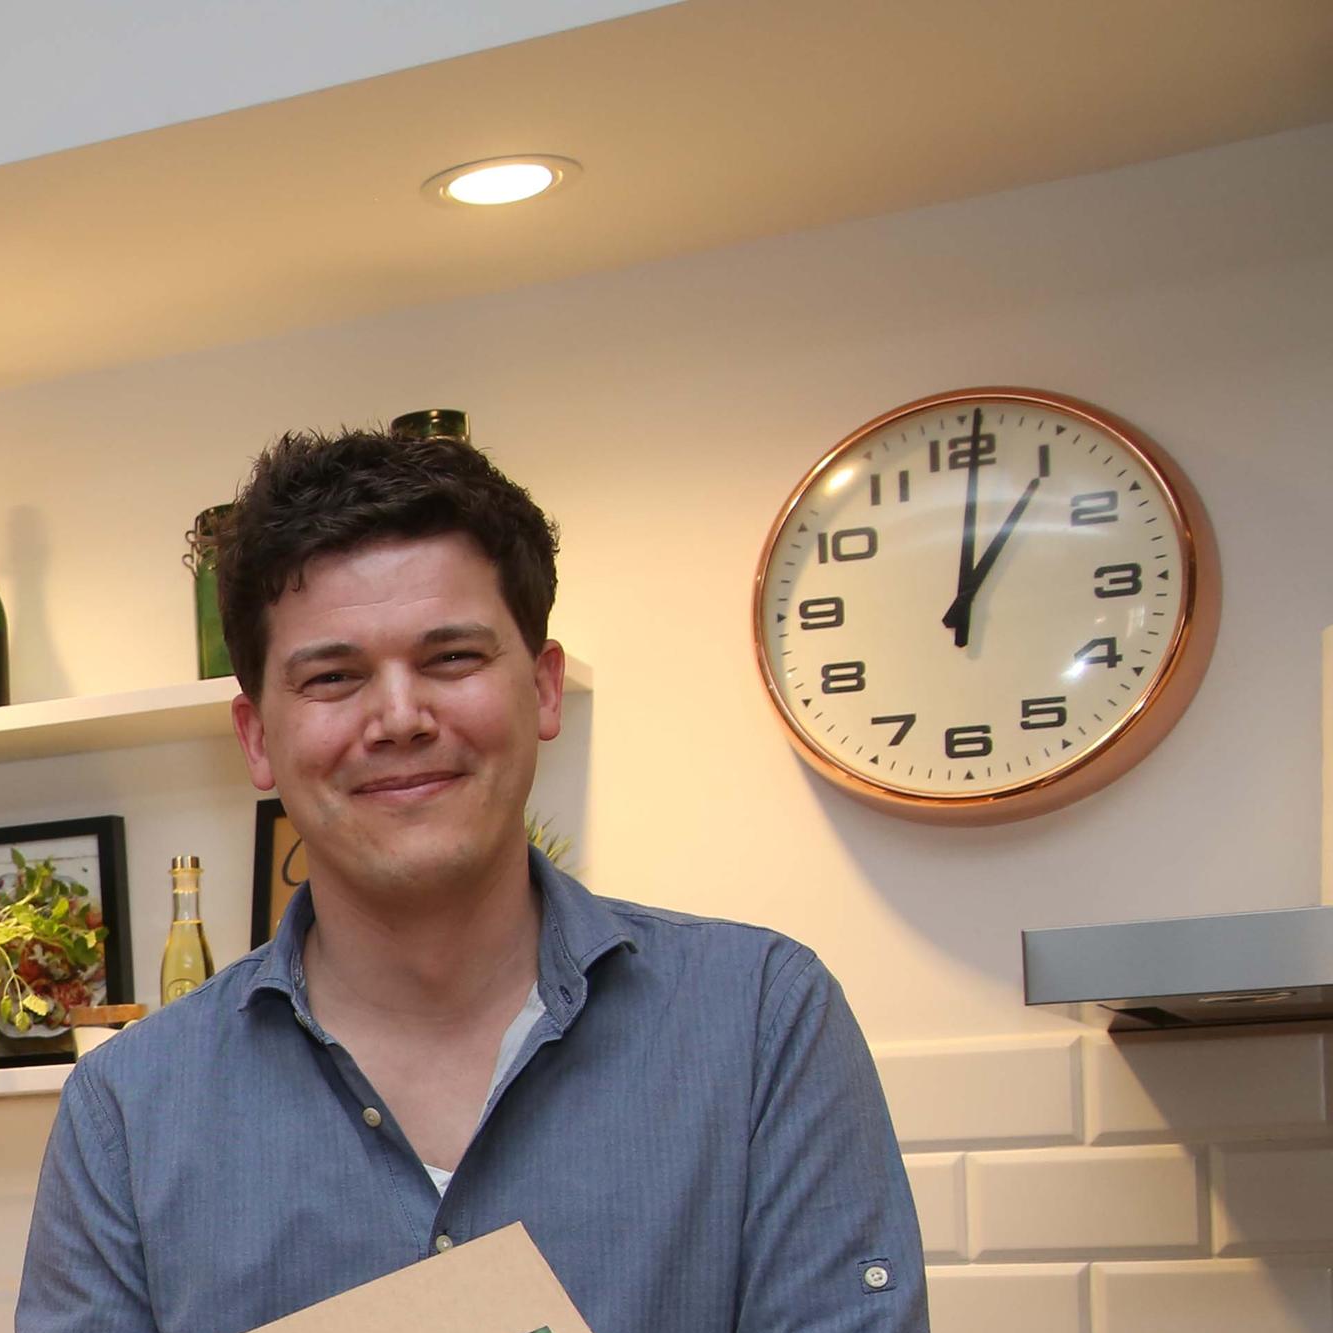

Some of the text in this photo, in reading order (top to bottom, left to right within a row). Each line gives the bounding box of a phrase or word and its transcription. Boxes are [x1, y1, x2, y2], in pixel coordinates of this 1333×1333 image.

[929, 433, 996, 471] 12
[870, 470, 910, 506] 11
[1070, 490, 1119, 527] 2
[817, 526, 878, 565] 10
[1094, 562, 1143, 599] 3
[799, 596, 845, 631] 9
[1074, 637, 1124, 669] 4
[820, 661, 866, 695] 8
[871, 713, 917, 747] 7
[1020, 696, 1068, 731] 5
[945, 724, 993, 760] 6
